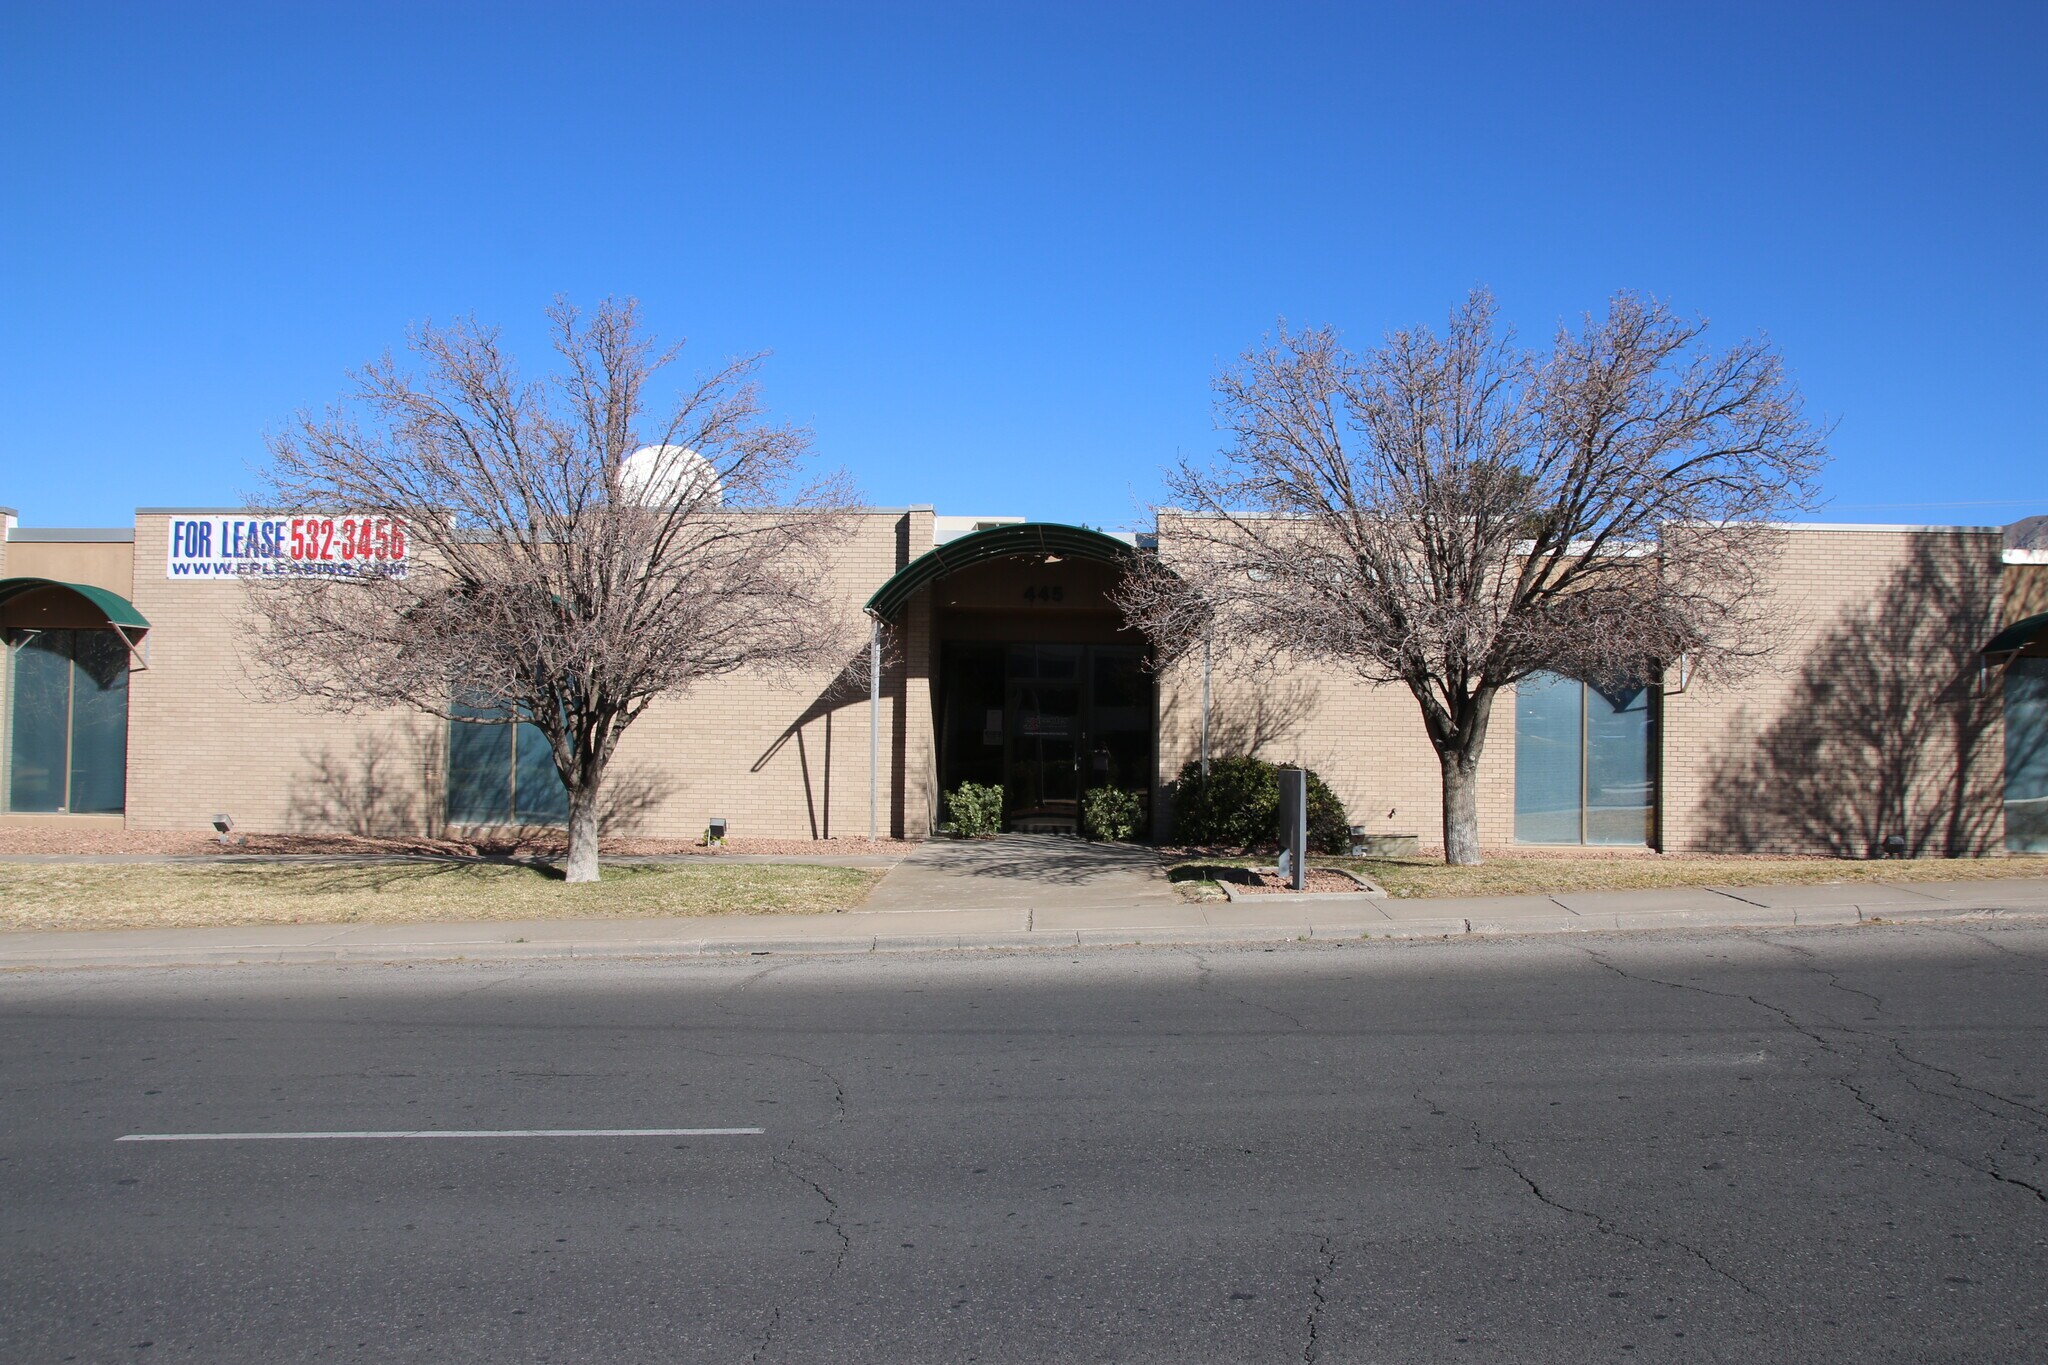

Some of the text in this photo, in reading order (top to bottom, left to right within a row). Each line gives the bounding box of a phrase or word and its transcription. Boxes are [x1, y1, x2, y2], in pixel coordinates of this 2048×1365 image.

[173, 519, 405, 560] FOR LEASE 532-3456
[1024, 585, 1064, 602] 445
